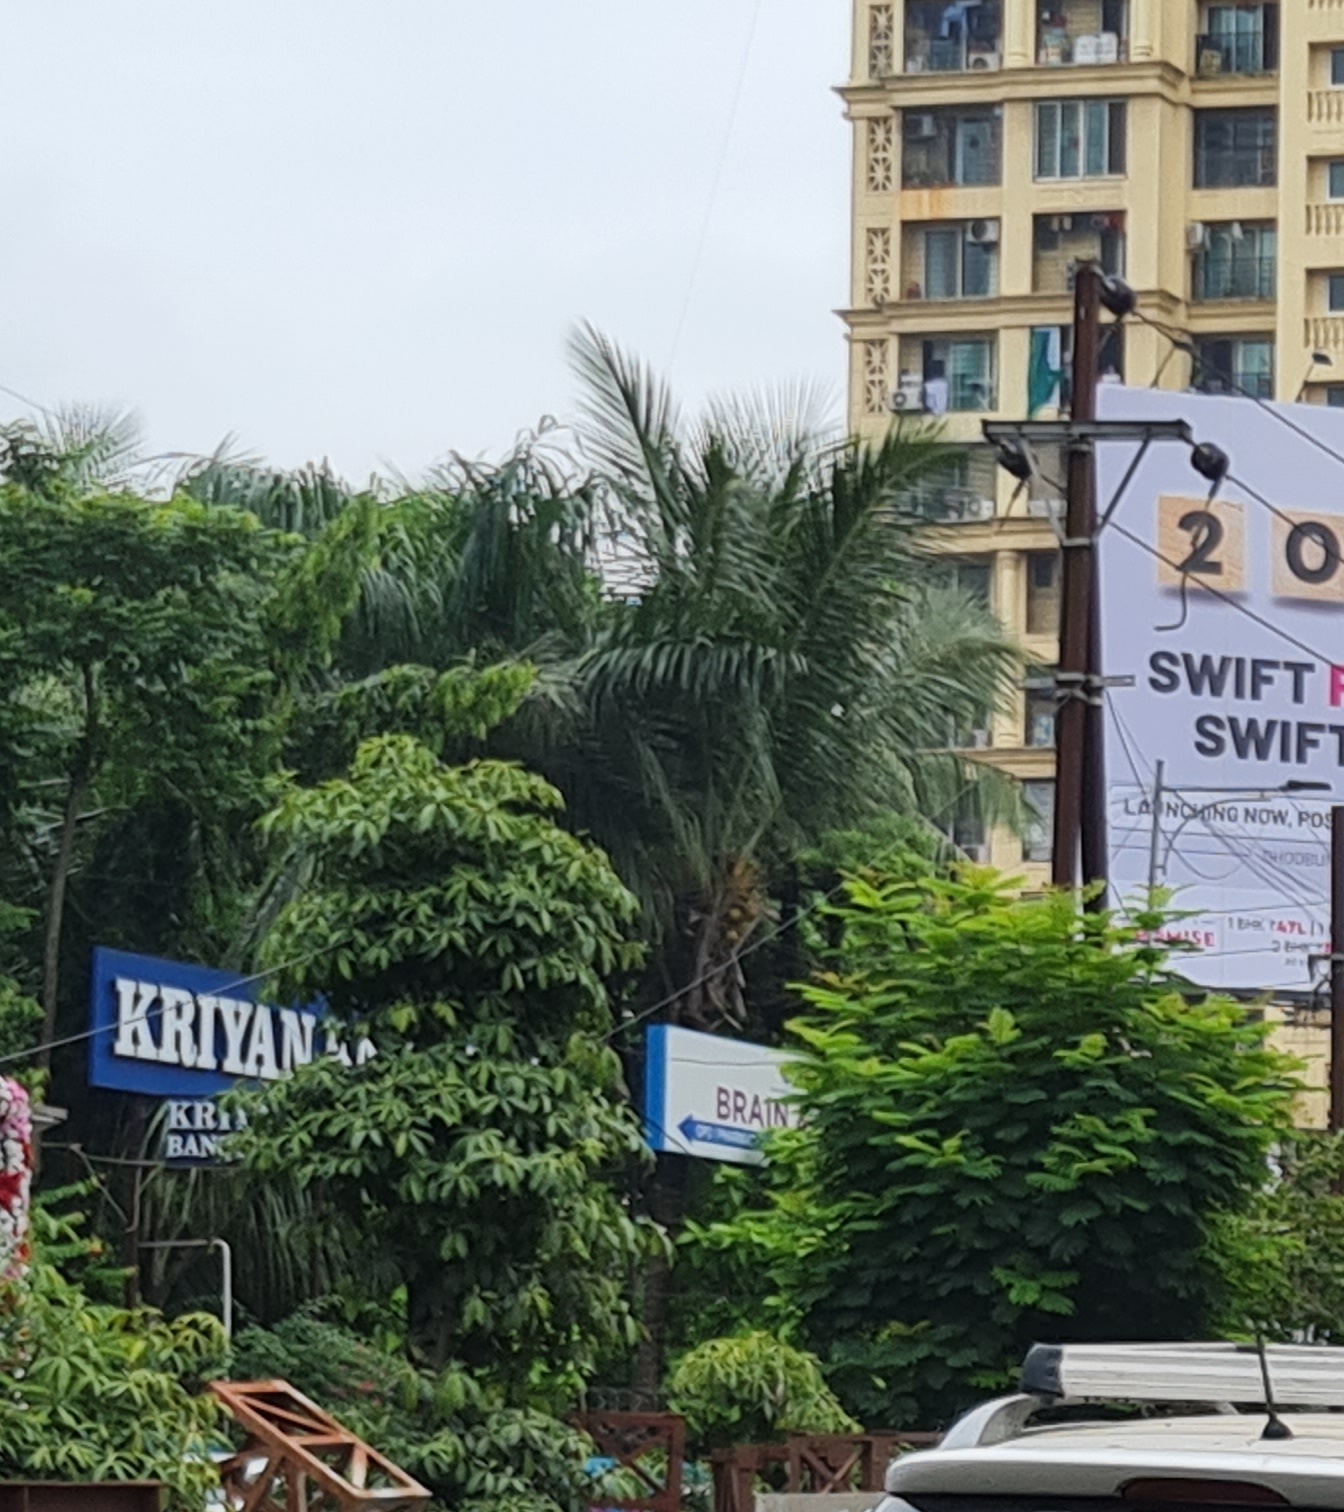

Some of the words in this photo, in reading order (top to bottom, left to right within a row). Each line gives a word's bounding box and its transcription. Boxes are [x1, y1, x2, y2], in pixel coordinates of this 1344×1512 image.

[1148, 650, 1316, 705] SWIFT
[1244, 807, 1293, 828] NOW,
[716, 1086, 790, 1128] BRAIN
